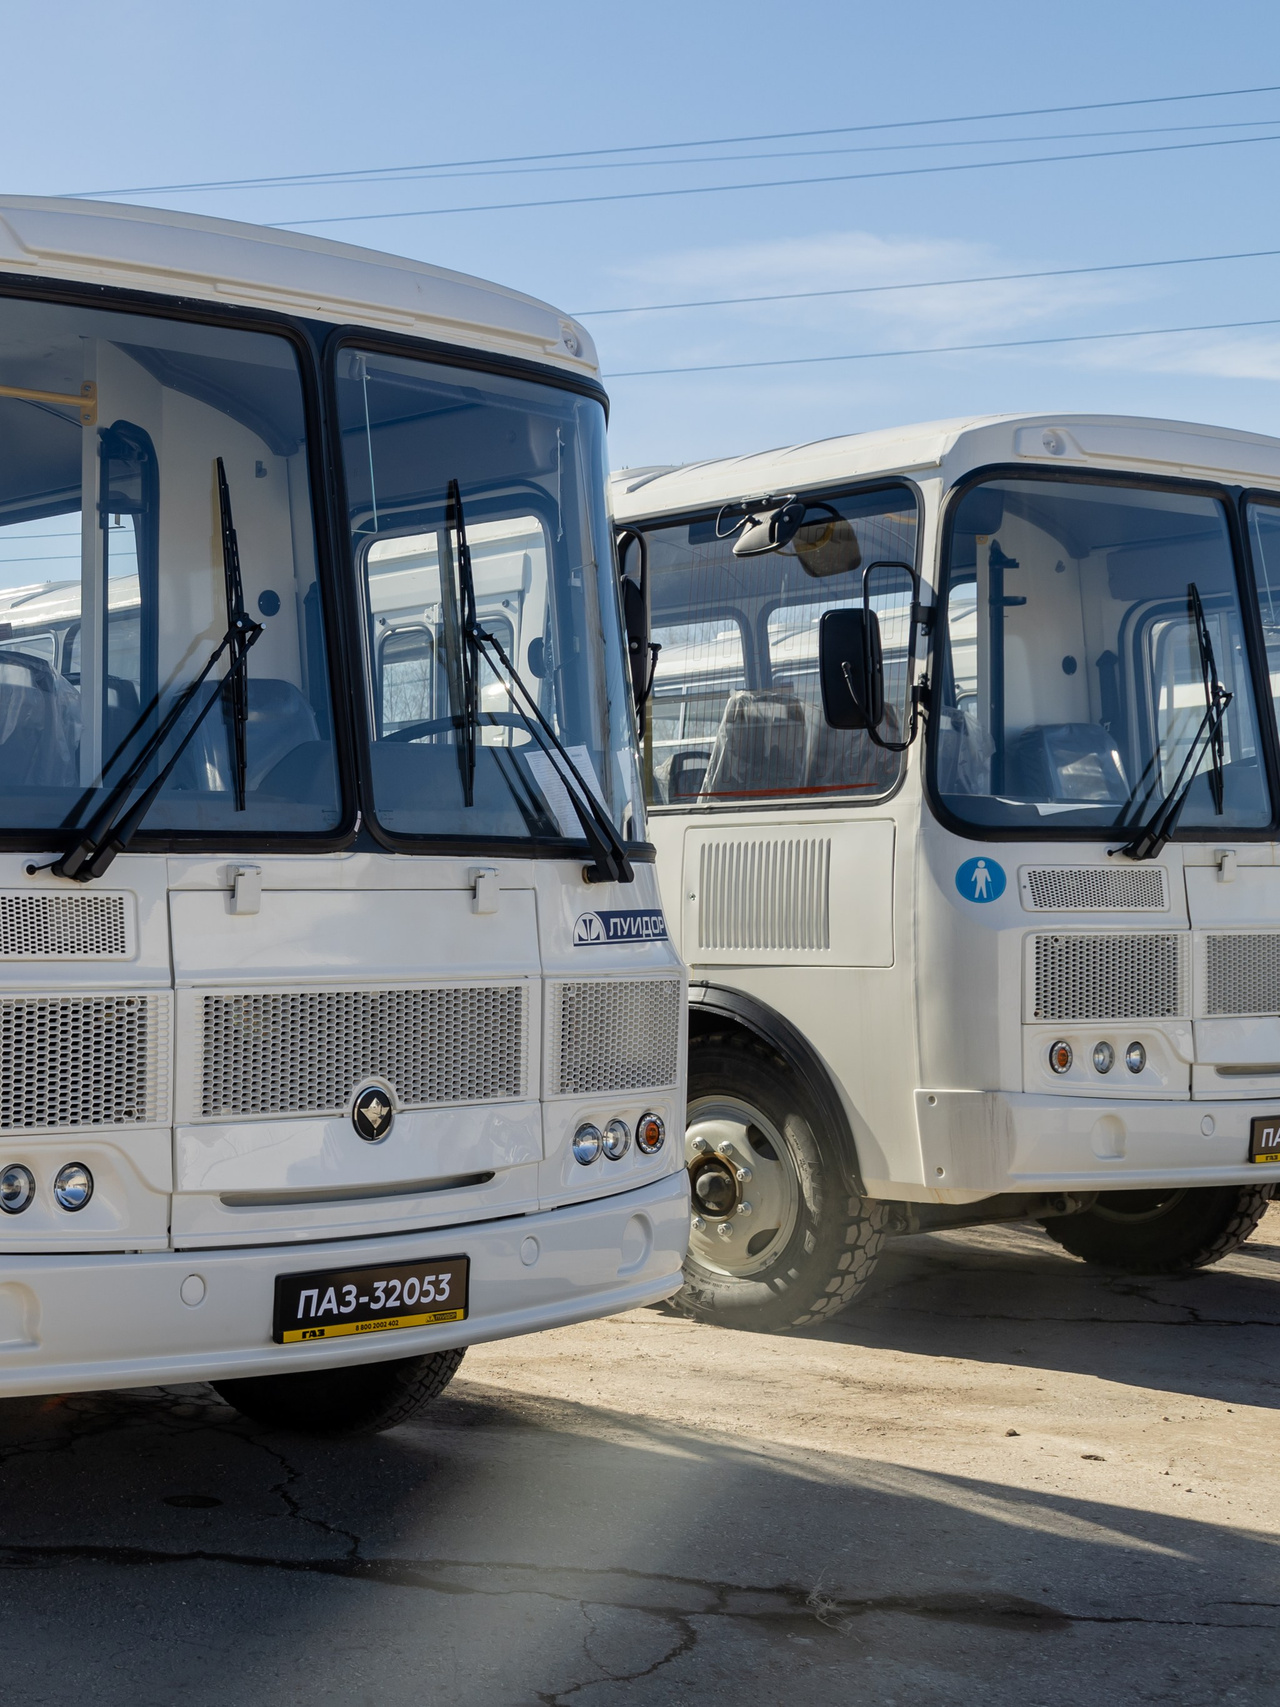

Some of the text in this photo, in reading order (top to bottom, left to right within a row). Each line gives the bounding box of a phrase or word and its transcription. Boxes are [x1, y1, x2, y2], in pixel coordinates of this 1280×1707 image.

[609, 916, 665, 938] ЛУИДОР
[297, 1273, 452, 1318] ПАЗ-32053
[302, 1329, 325, 1339] ГАЗ
[360, 1323, 372, 1331] 800
[373, 1321, 387, 1329] 2002
